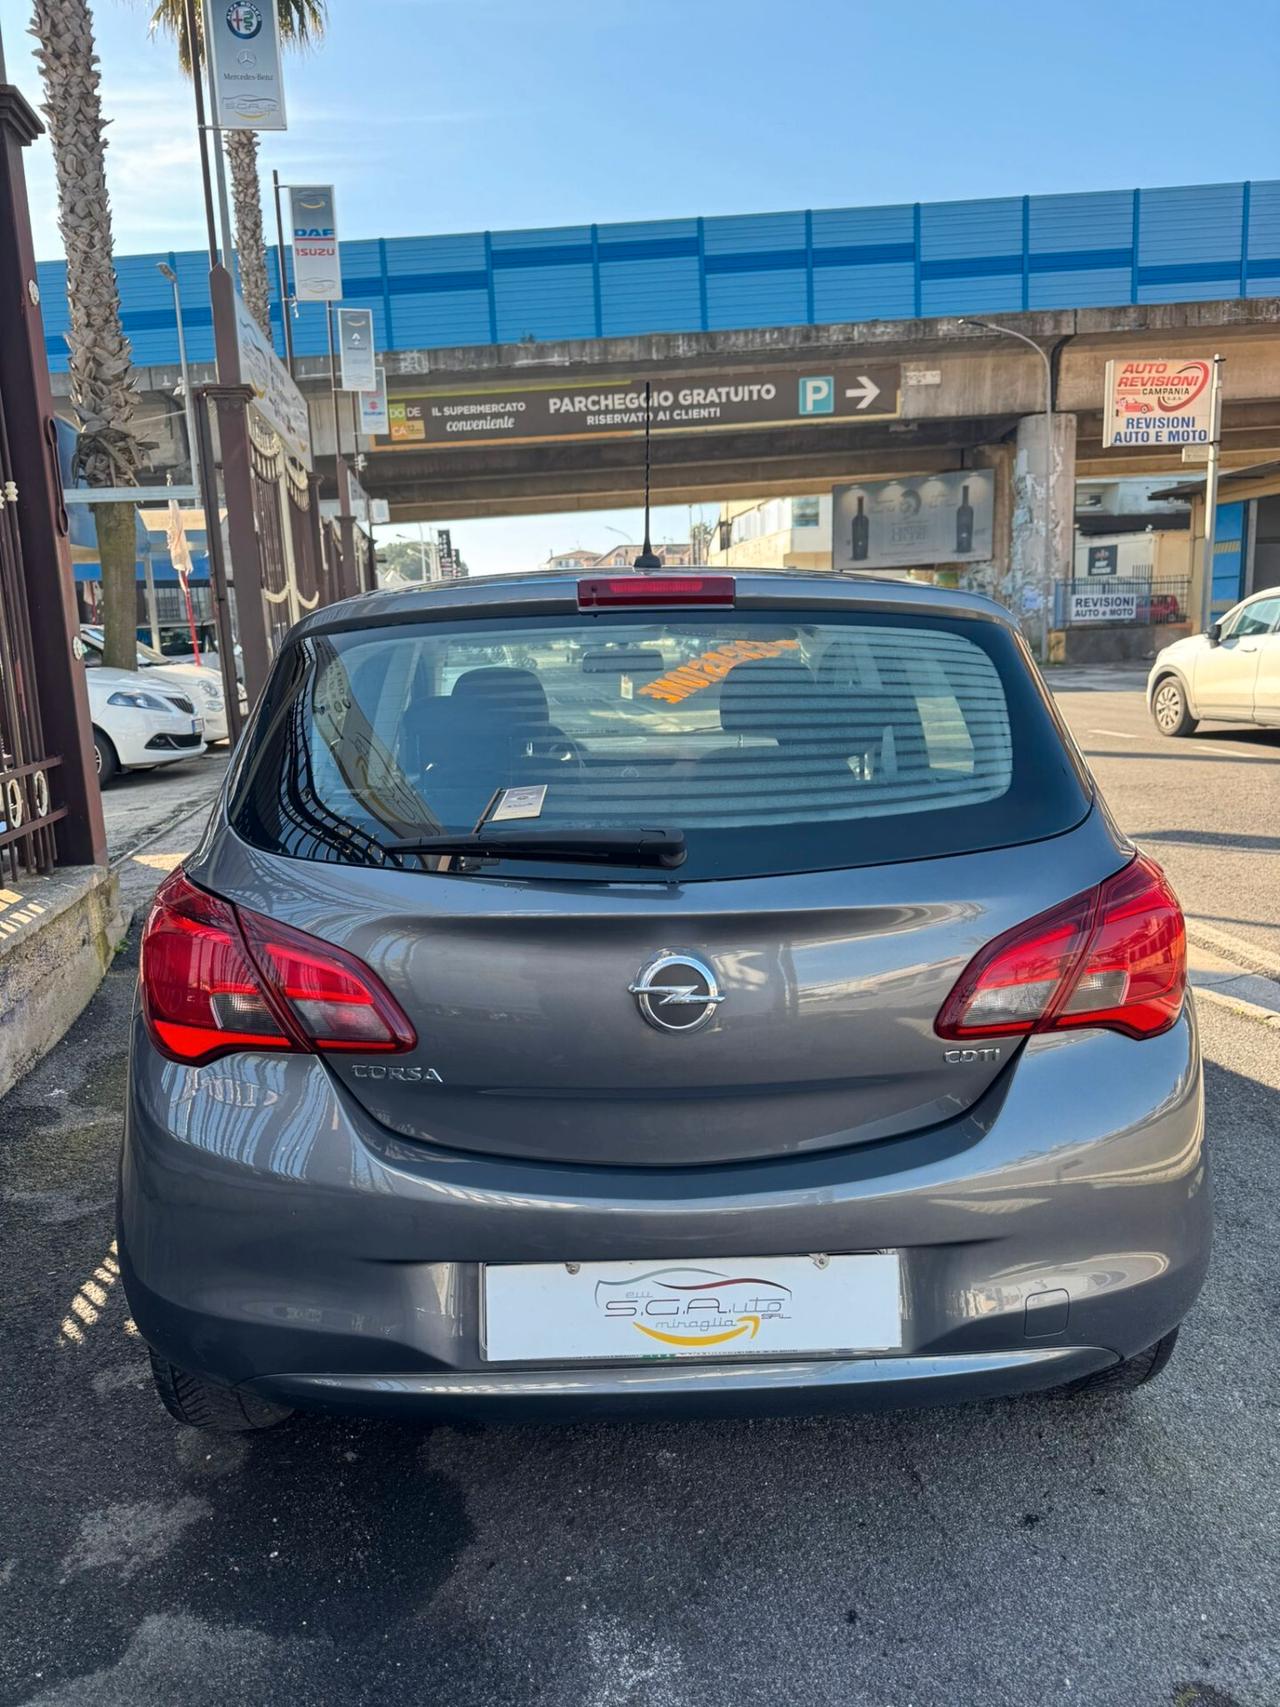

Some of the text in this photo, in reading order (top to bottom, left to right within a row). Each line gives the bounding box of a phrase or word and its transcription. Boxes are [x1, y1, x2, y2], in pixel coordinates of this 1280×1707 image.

[294, 228, 334, 237] DAF
[296, 248, 335, 256] ISUZU
[1122, 363, 1168, 375] AUTO
[1118, 376, 1200, 388] REVISIONI
[549, 383, 777, 414] PARCHEGGIO GRATUITO
[805, 380, 829, 411] P
[1142, 387, 1190, 396] CAMPANIA
[431, 401, 526, 417] IL SUPERMERCATO
[586, 406, 721, 426] RISERVATO AI CLIENTI
[446, 415, 516, 432] conveniente
[1126, 416, 1195, 430] REVISIONI
[1114, 429, 1208, 444] AUTO E MOTO
[1074, 597, 1134, 608] REVISIONI
[1074, 609, 1100, 617] AUTO
[1108, 608, 1134, 617] MOTO
[943, 1047, 1001, 1064] CDTI
[351, 1064, 444, 1083] CORSA
[655, 1317, 737, 1332] miraglia
